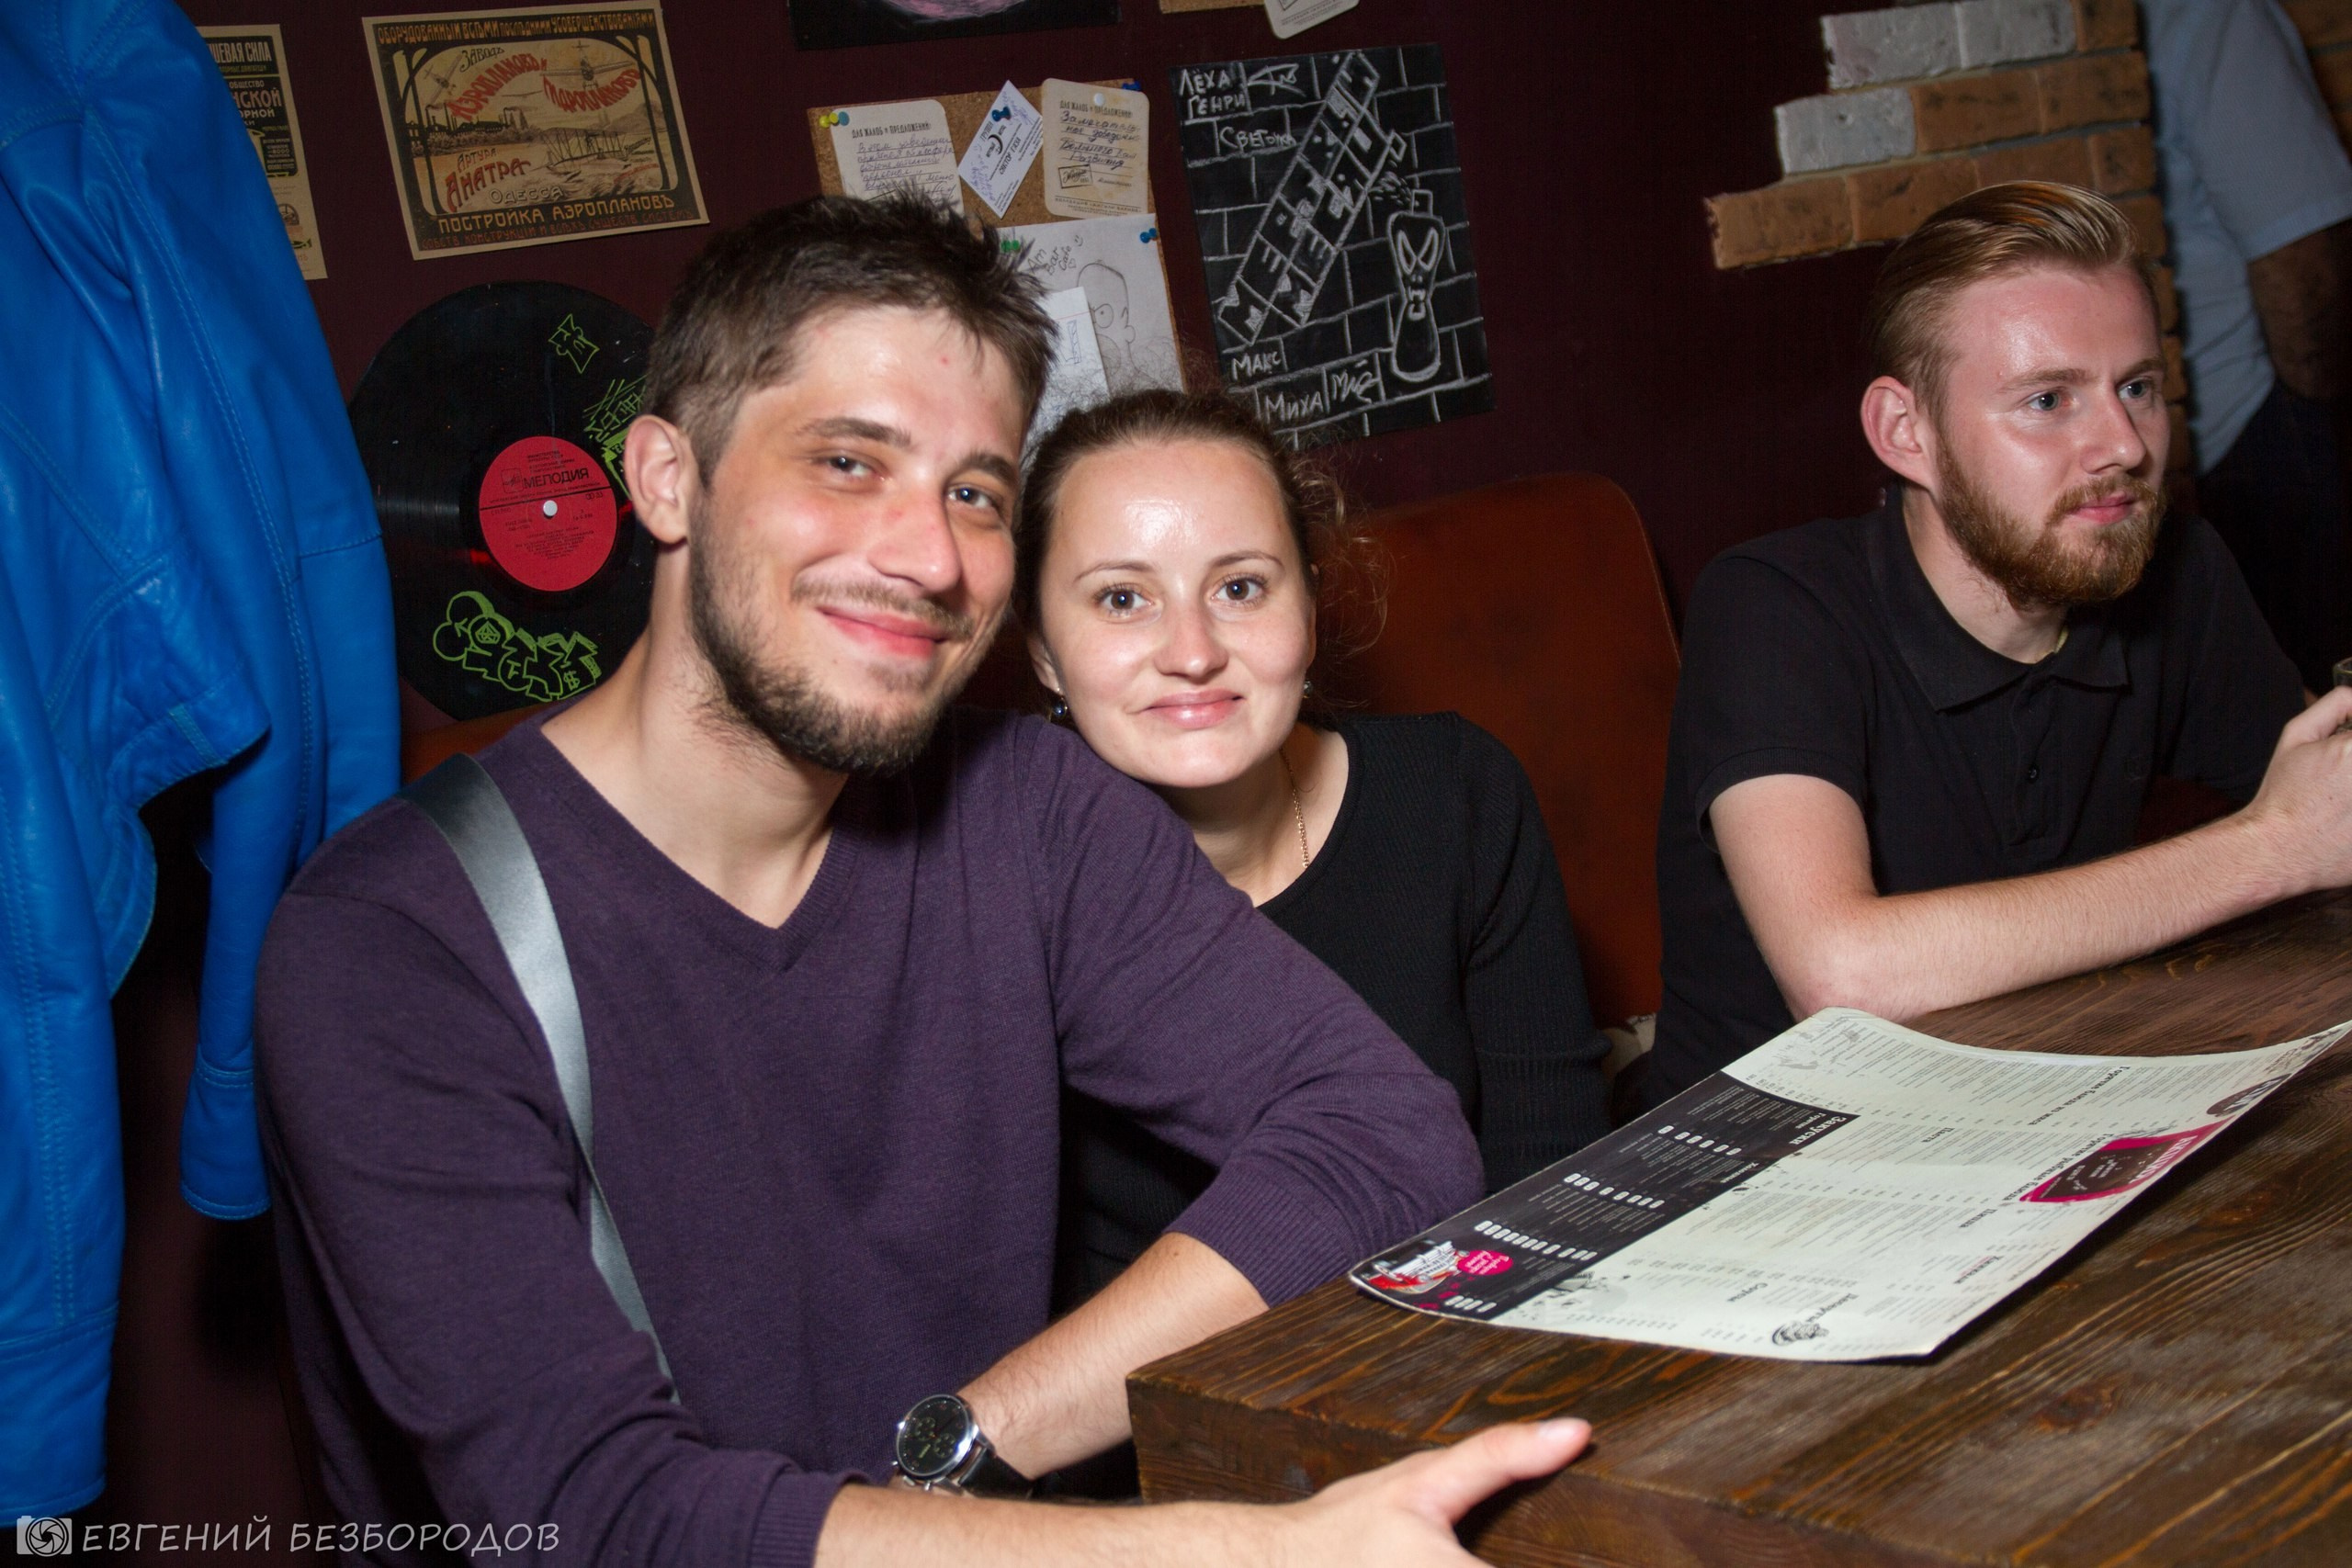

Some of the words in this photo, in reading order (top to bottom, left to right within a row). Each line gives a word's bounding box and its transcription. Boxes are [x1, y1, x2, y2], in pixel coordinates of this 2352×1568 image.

[245, 41, 272, 62] СИЛА
[445, 158, 531, 212] АНАТРА
[489, 186, 564, 204] ОДЕССА
[438, 208, 545, 234] ПОСТРОЙКА
[553, 195, 674, 221] АЭРОПЛАНОВЪ
[523, 468, 589, 489] МЕЛОДИЯ
[1788, 1115, 1847, 1145] Закуски
